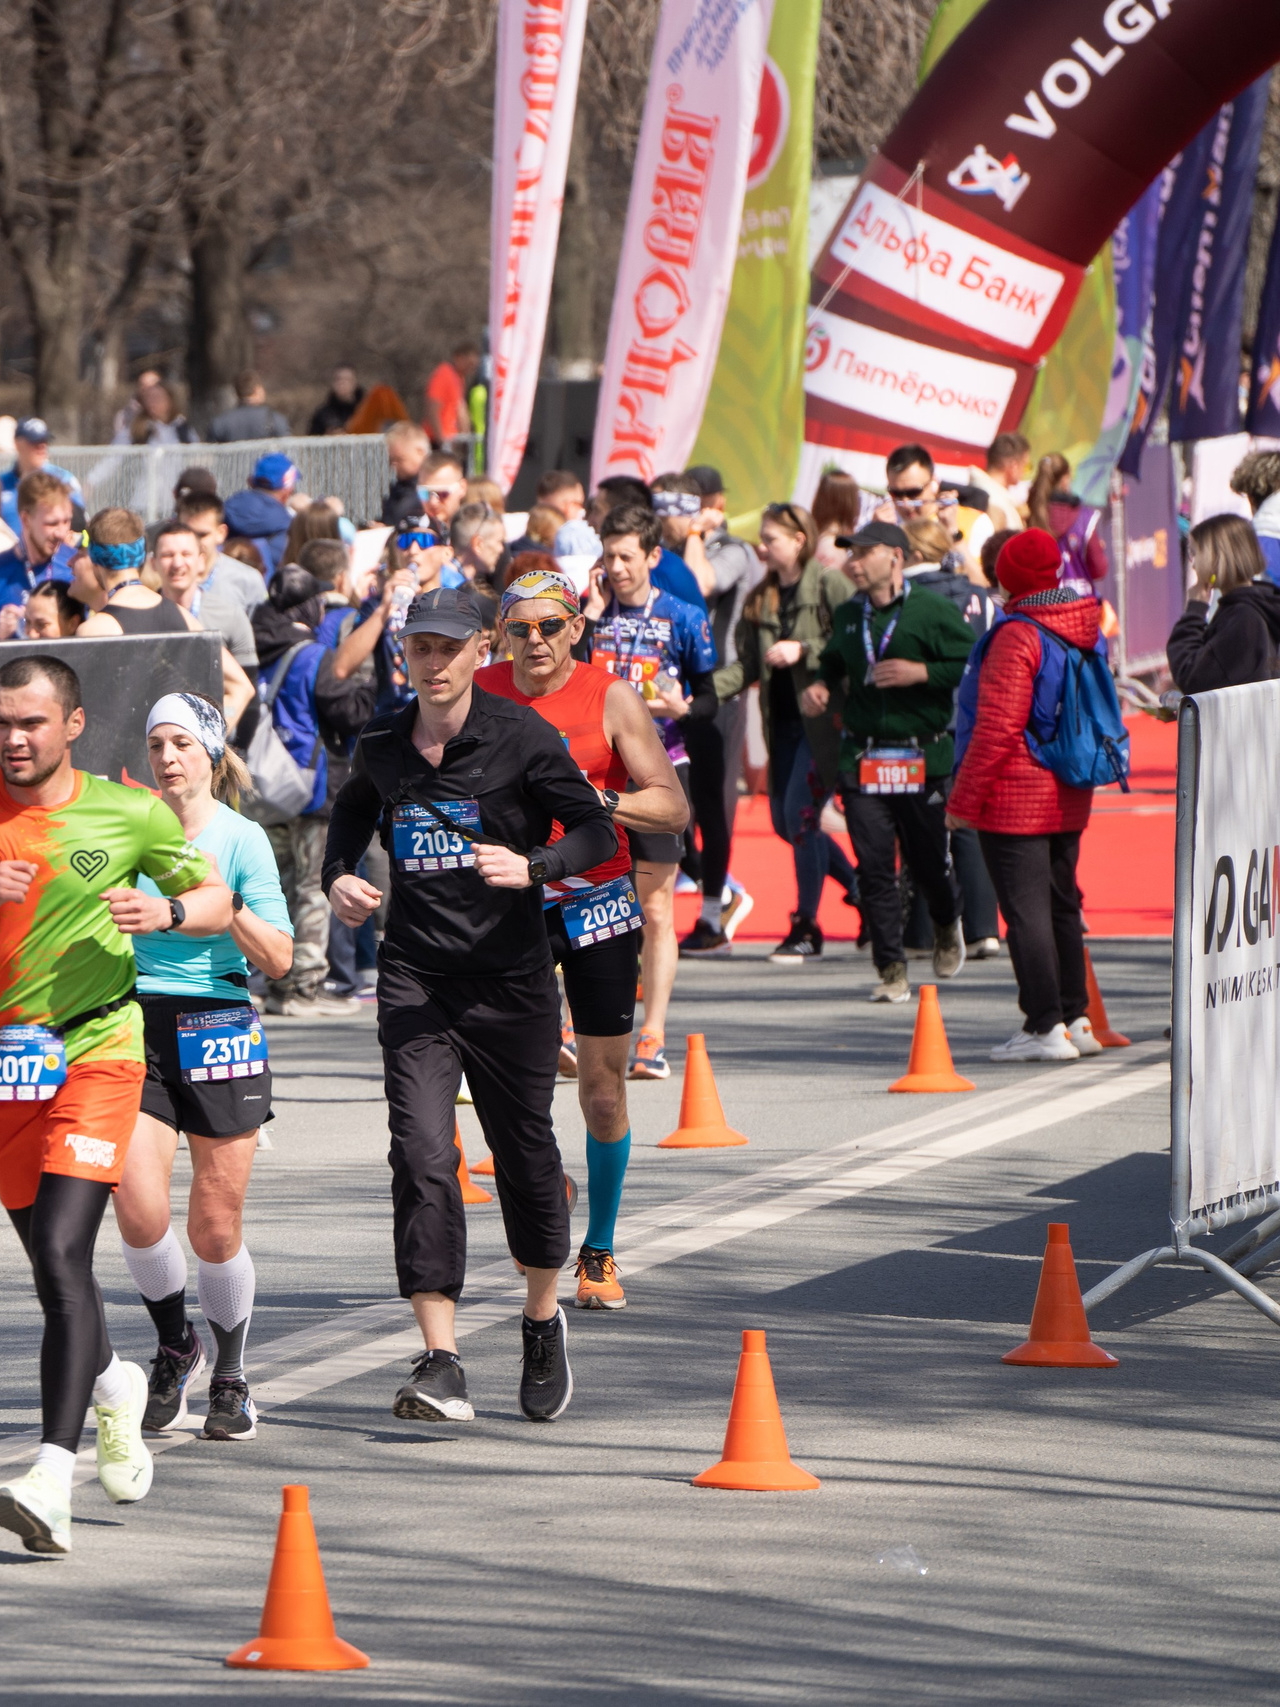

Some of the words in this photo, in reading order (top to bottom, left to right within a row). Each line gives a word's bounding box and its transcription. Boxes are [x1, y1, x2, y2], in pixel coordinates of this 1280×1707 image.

[848, 201, 953, 280] Альфа
[957, 256, 1046, 318] Банк
[832, 348, 1001, 420] Пятёрочка
[877, 766, 908, 783] 1191
[411, 829, 464, 855] 2103
[580, 895, 631, 931] 2026
[202, 1034, 250, 1065] 2317
